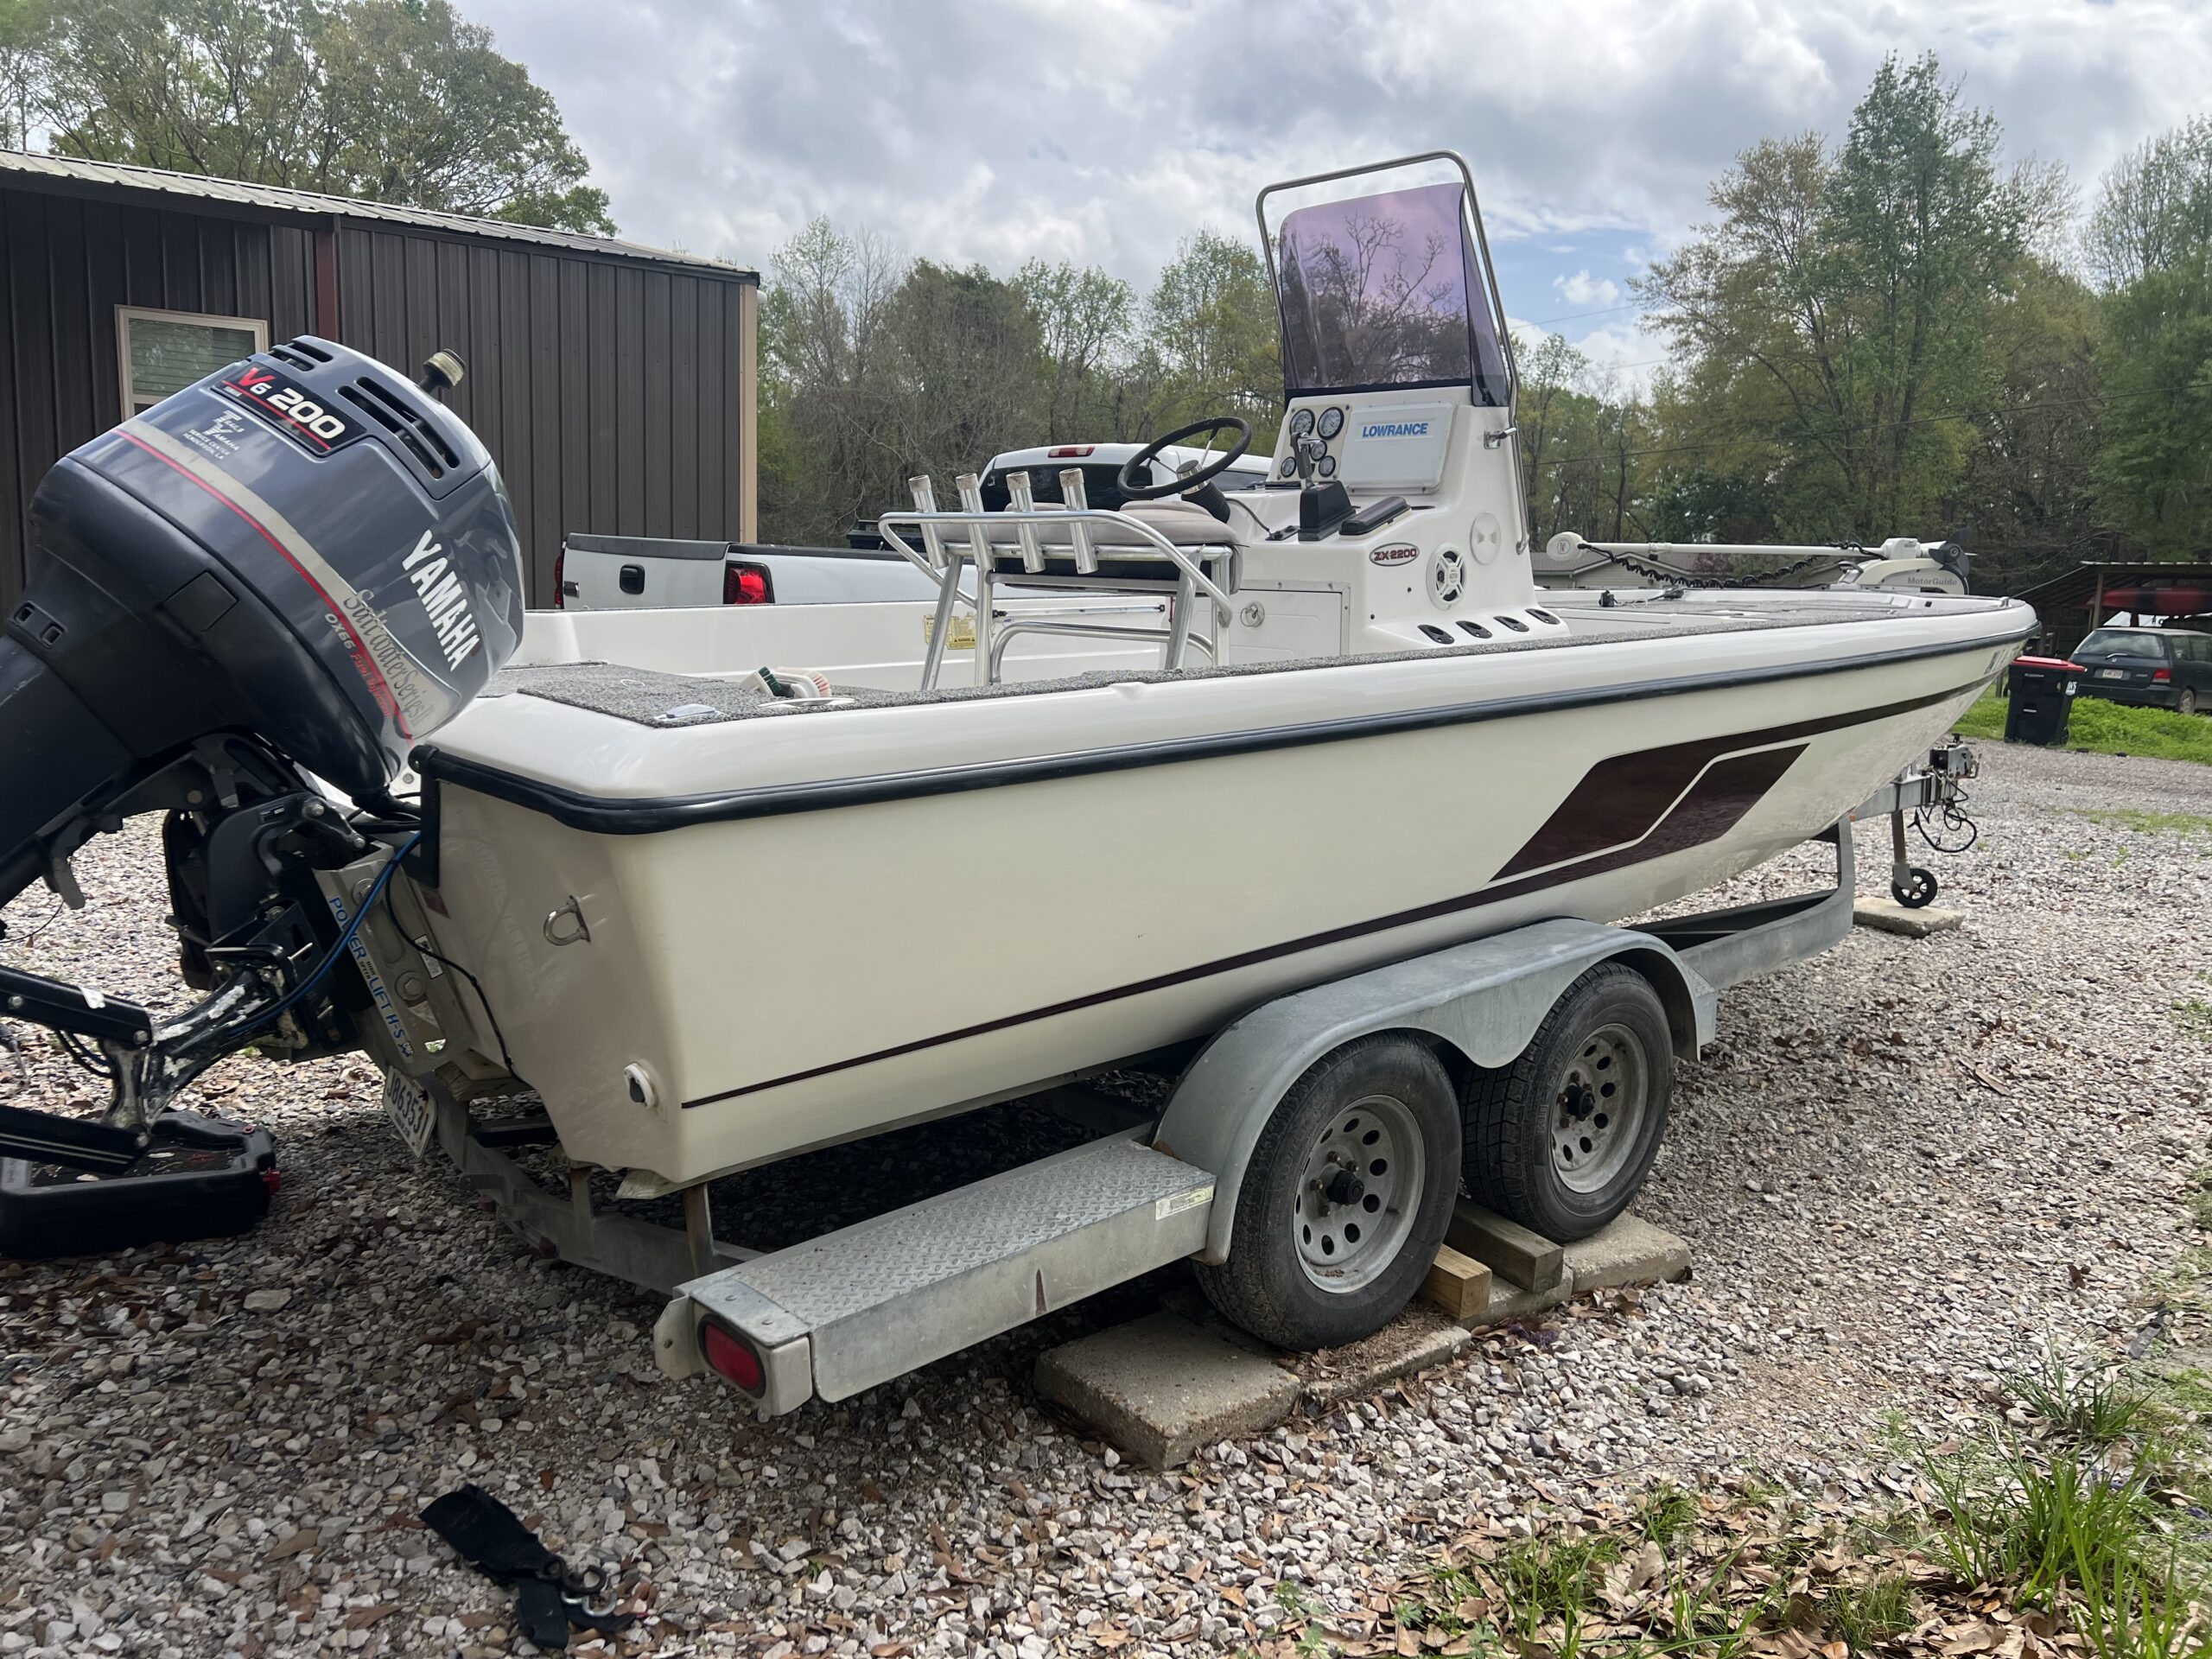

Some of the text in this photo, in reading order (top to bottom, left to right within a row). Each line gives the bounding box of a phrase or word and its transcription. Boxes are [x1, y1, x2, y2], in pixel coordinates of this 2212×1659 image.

[267, 387, 346, 439] 200
[1362, 423, 1428, 438] LOWRANCE
[1907, 576, 1958, 587] MotorGuide
[402, 530, 480, 672] YAMAHA
[325, 613, 356, 649] OX66
[366, 961, 376, 976] HIGH
[369, 976, 393, 1010] LIFT
